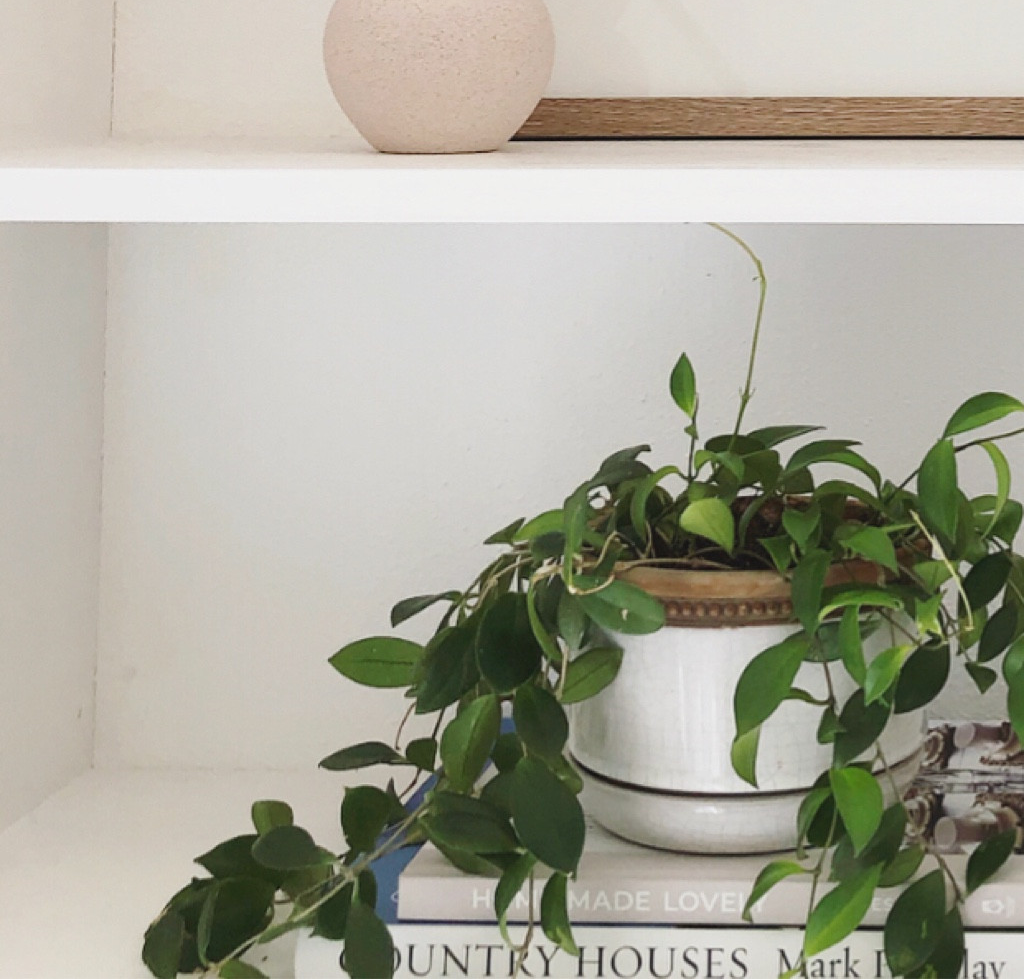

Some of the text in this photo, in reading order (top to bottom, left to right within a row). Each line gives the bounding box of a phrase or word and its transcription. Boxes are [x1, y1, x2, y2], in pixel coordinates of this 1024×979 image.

[568, 889, 650, 912] MADE
[339, 943, 562, 978] UNTRY
[576, 945, 749, 979] HOUSES
[777, 947, 862, 979] Mark
